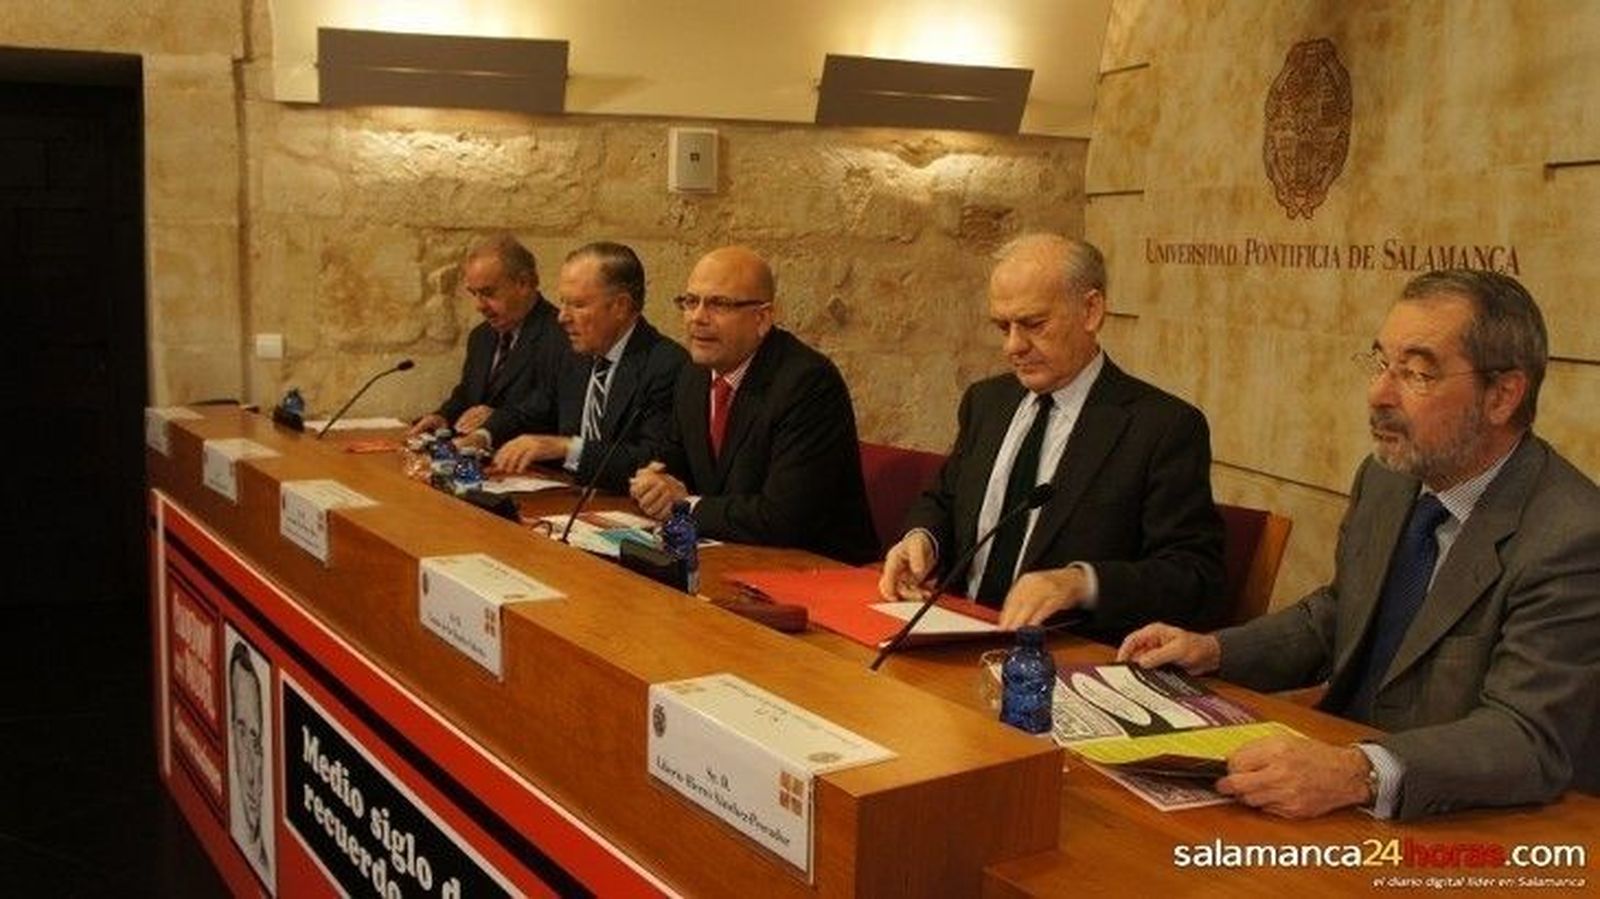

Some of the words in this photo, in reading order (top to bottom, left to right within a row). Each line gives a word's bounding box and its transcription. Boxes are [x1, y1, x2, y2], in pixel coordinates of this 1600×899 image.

[1244, 238, 1341, 269] PONTIFICIA
[1348, 245, 1375, 271] DE
[302, 725, 365, 819] Medio
[370, 806, 433, 891] siglo
[303, 783, 402, 899] recuerdo
